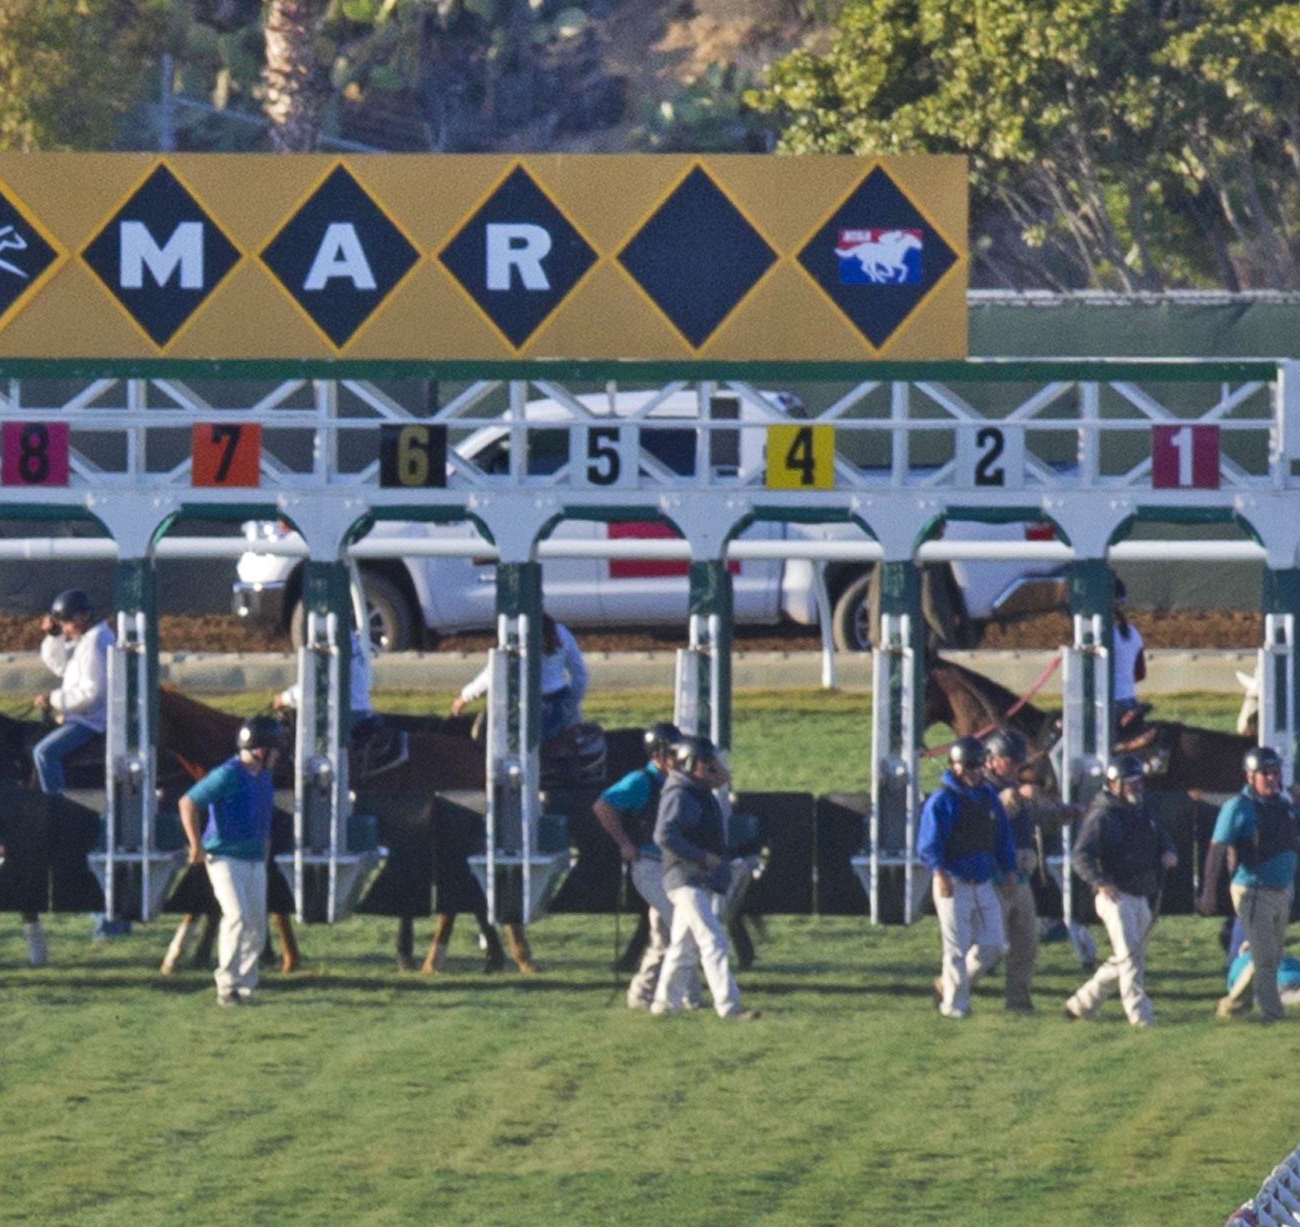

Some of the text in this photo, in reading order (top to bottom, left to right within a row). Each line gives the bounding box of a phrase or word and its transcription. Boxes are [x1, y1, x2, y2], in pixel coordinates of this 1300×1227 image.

[120, 221, 551, 290] MAR
[19, 422, 50, 484] 8
[210, 423, 243, 483] 7
[396, 425, 429, 486] 6
[586, 425, 620, 485] 5
[785, 425, 816, 485] 4
[974, 426, 1005, 486] 2
[1170, 428, 1193, 487] 1
